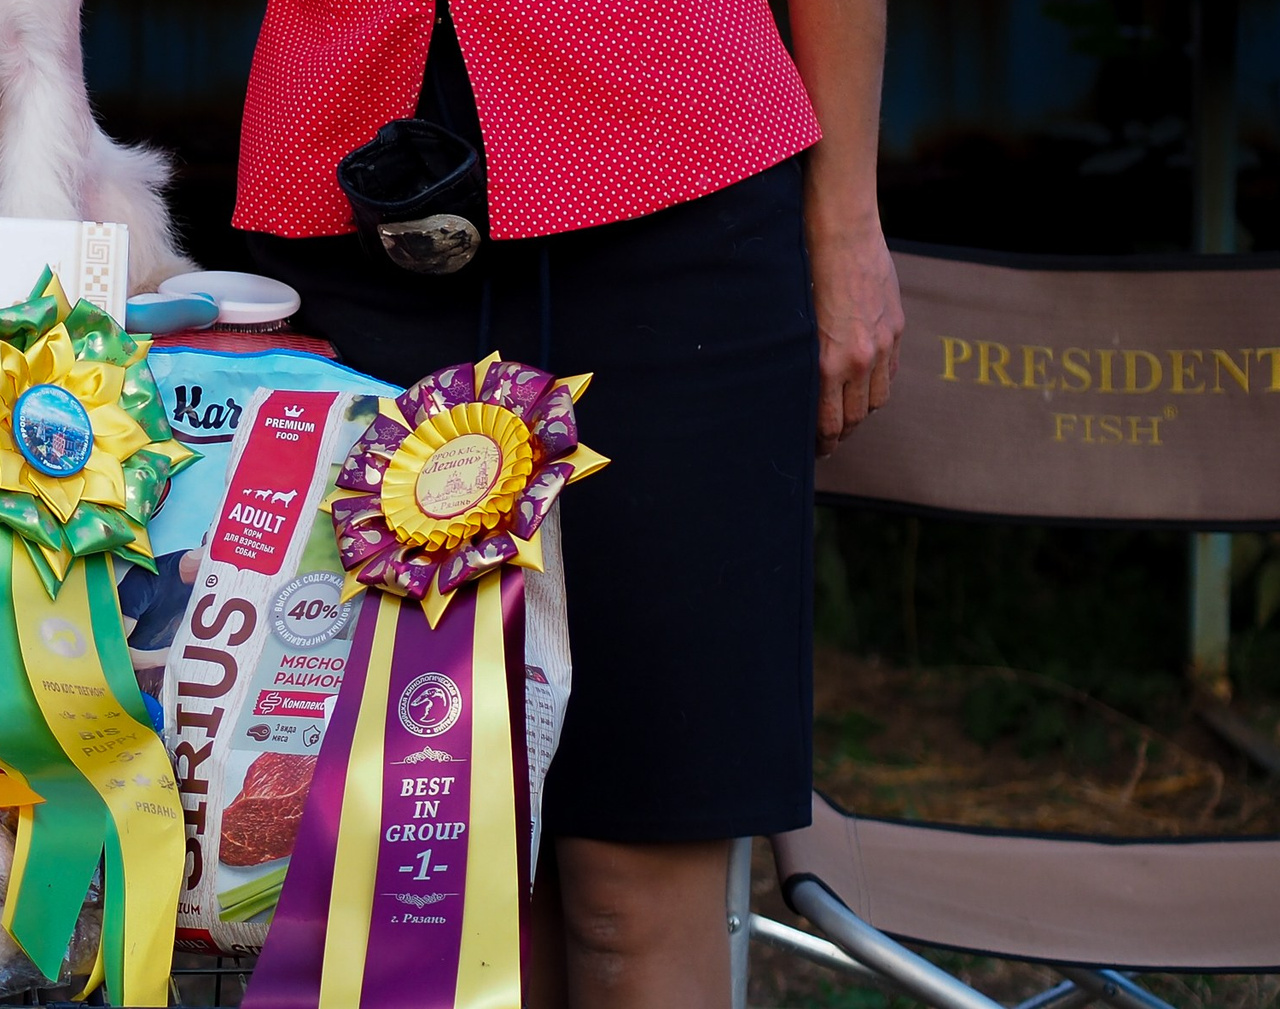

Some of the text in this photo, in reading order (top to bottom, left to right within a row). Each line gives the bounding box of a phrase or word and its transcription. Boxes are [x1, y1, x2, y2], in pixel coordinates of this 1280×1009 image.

[264, 417, 316, 432] PREMIUM
[275, 431, 300, 441] FOOD
[422, 455, 481, 475] «Легион»
[227, 502, 287, 535] ADULT
[243, 527, 263, 540] КОРМ
[223, 532, 275, 555] ДЛЯ ВЗРОСЛЫХ
[234, 545, 257, 560] СОБАК
[274, 578, 303, 612] ВЫСОКОЕ
[287, 599, 338, 621] 40%
[326, 602, 352, 637] ИВОТНЫХ
[275, 620, 327, 647] ИНГРЕДИЕНТОВ
[280, 654, 346, 672] МЯСНО
[78, 727, 121, 741] BIS
[272, 733, 289, 743] мяса
[280, 724, 297, 734] вида
[81, 732, 138, 757] PUPPY
[400, 777, 455, 797] BEST
[134, 801, 177, 820] РЯЗАНЬ
[413, 801, 440, 819] IN
[385, 822, 466, 843] GROUP
[398, 848, 448, 881] -1-
[391, 913, 447, 925] г. Рязань
